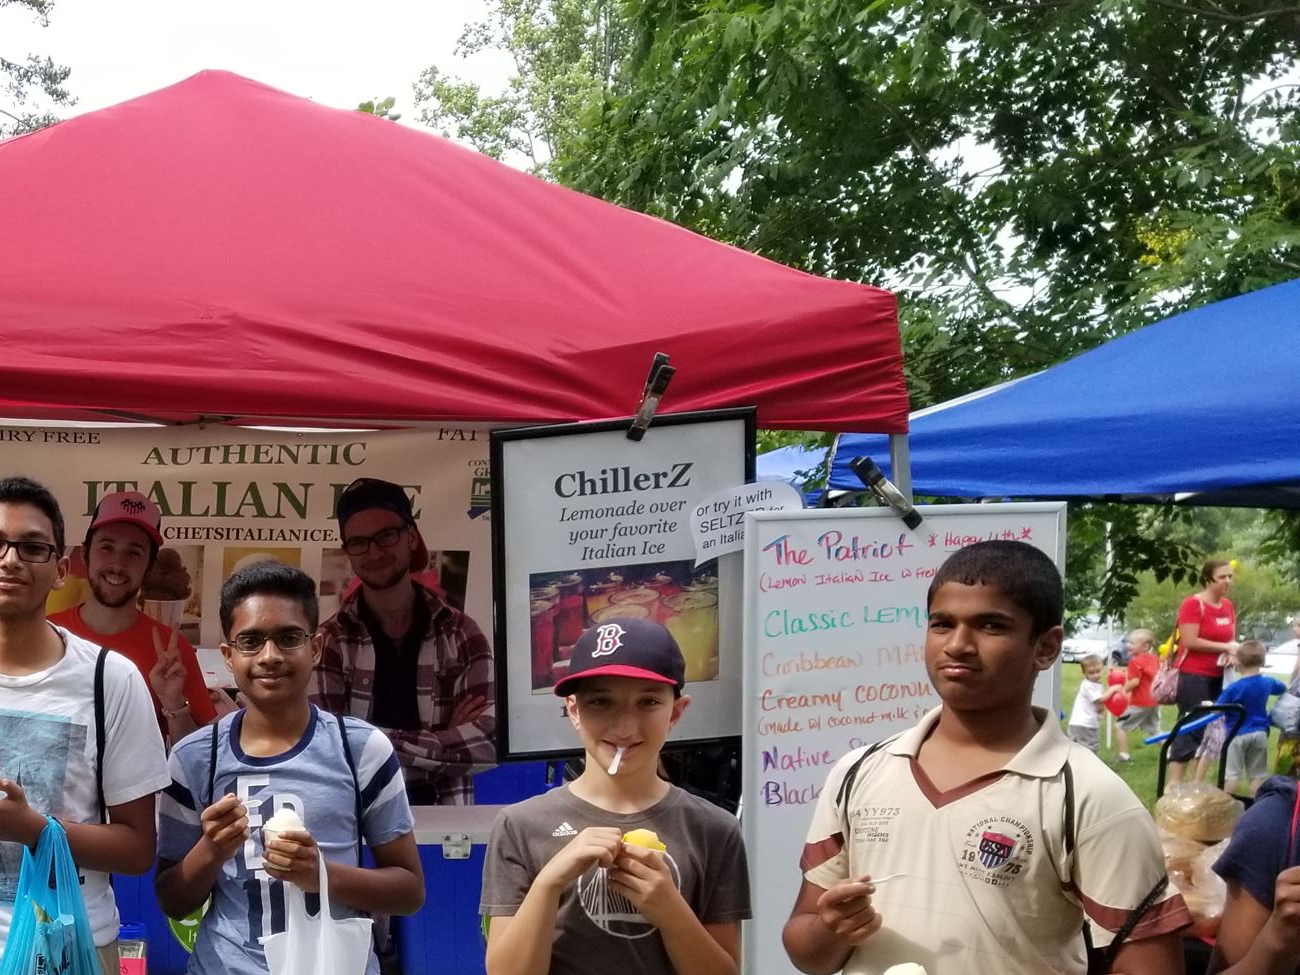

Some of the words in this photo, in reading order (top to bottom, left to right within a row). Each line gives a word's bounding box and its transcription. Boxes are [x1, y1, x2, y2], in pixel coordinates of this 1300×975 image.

[43, 430, 101, 445] FREE
[140, 442, 367, 466] AUTHENTIC
[554, 462, 695, 498] ChillerZ
[559, 502, 645, 523] Lemonade
[649, 500, 687, 514] over
[696, 505, 710, 517] or
[714, 499, 730, 514] try
[734, 495, 742, 507] it
[745, 488, 772, 505] with
[568, 527, 608, 544] your
[611, 519, 678, 541] favorite
[581, 543, 637, 561] Italian
[641, 541, 666, 556] Ice
[702, 539, 716, 549] an
[763, 534, 814, 565] The
[817, 530, 914, 561] Patriot
[815, 569, 864, 586] Italian
[869, 571, 895, 582] Ice
[764, 608, 855, 638] Classic
[864, 605, 929, 628] LEM
[591, 623, 627, 658] B
[761, 689, 843, 711] Creamy
[881, 707, 909, 721] milk
[762, 745, 836, 773] Native
[552, 829, 578, 837] adidas
[1000, 816, 1034, 855] CHAMPIONSHIP
[962, 849, 976, 861] 18
